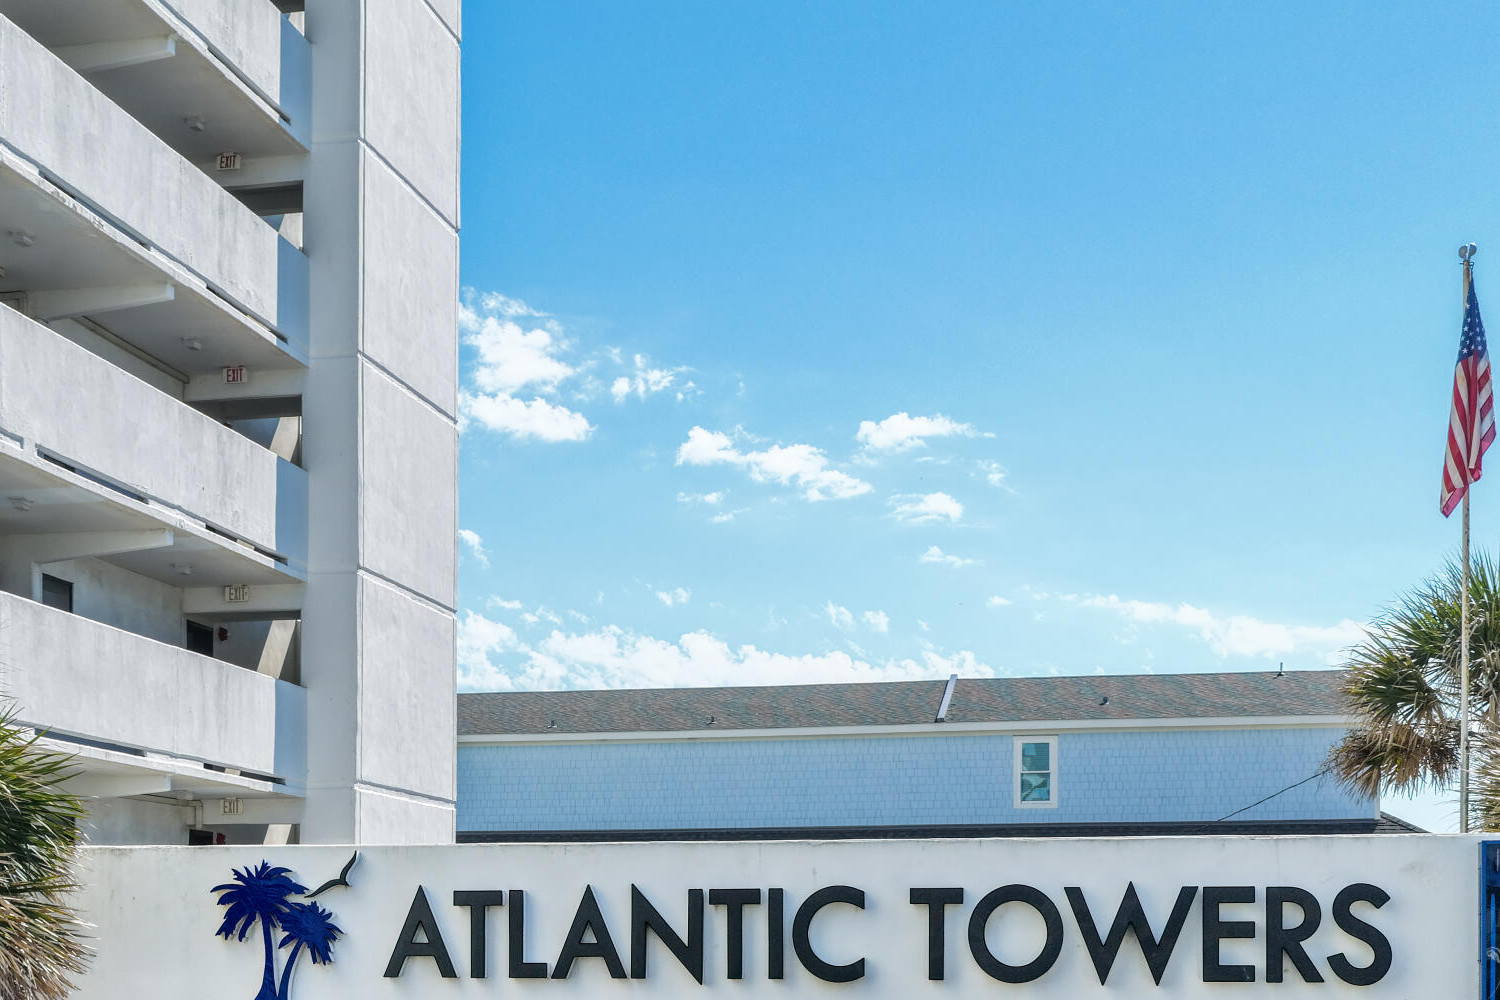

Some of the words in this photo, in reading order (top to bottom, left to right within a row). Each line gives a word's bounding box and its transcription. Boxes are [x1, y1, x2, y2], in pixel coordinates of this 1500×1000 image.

[220, 155, 236, 168] EXIT
[227, 368, 243, 382] EXIT
[229, 587, 244, 600] EXIT
[223, 800, 238, 813] EXIT
[383, 883, 866, 985] ATLANTIC
[909, 881, 1393, 987] TOWERS
